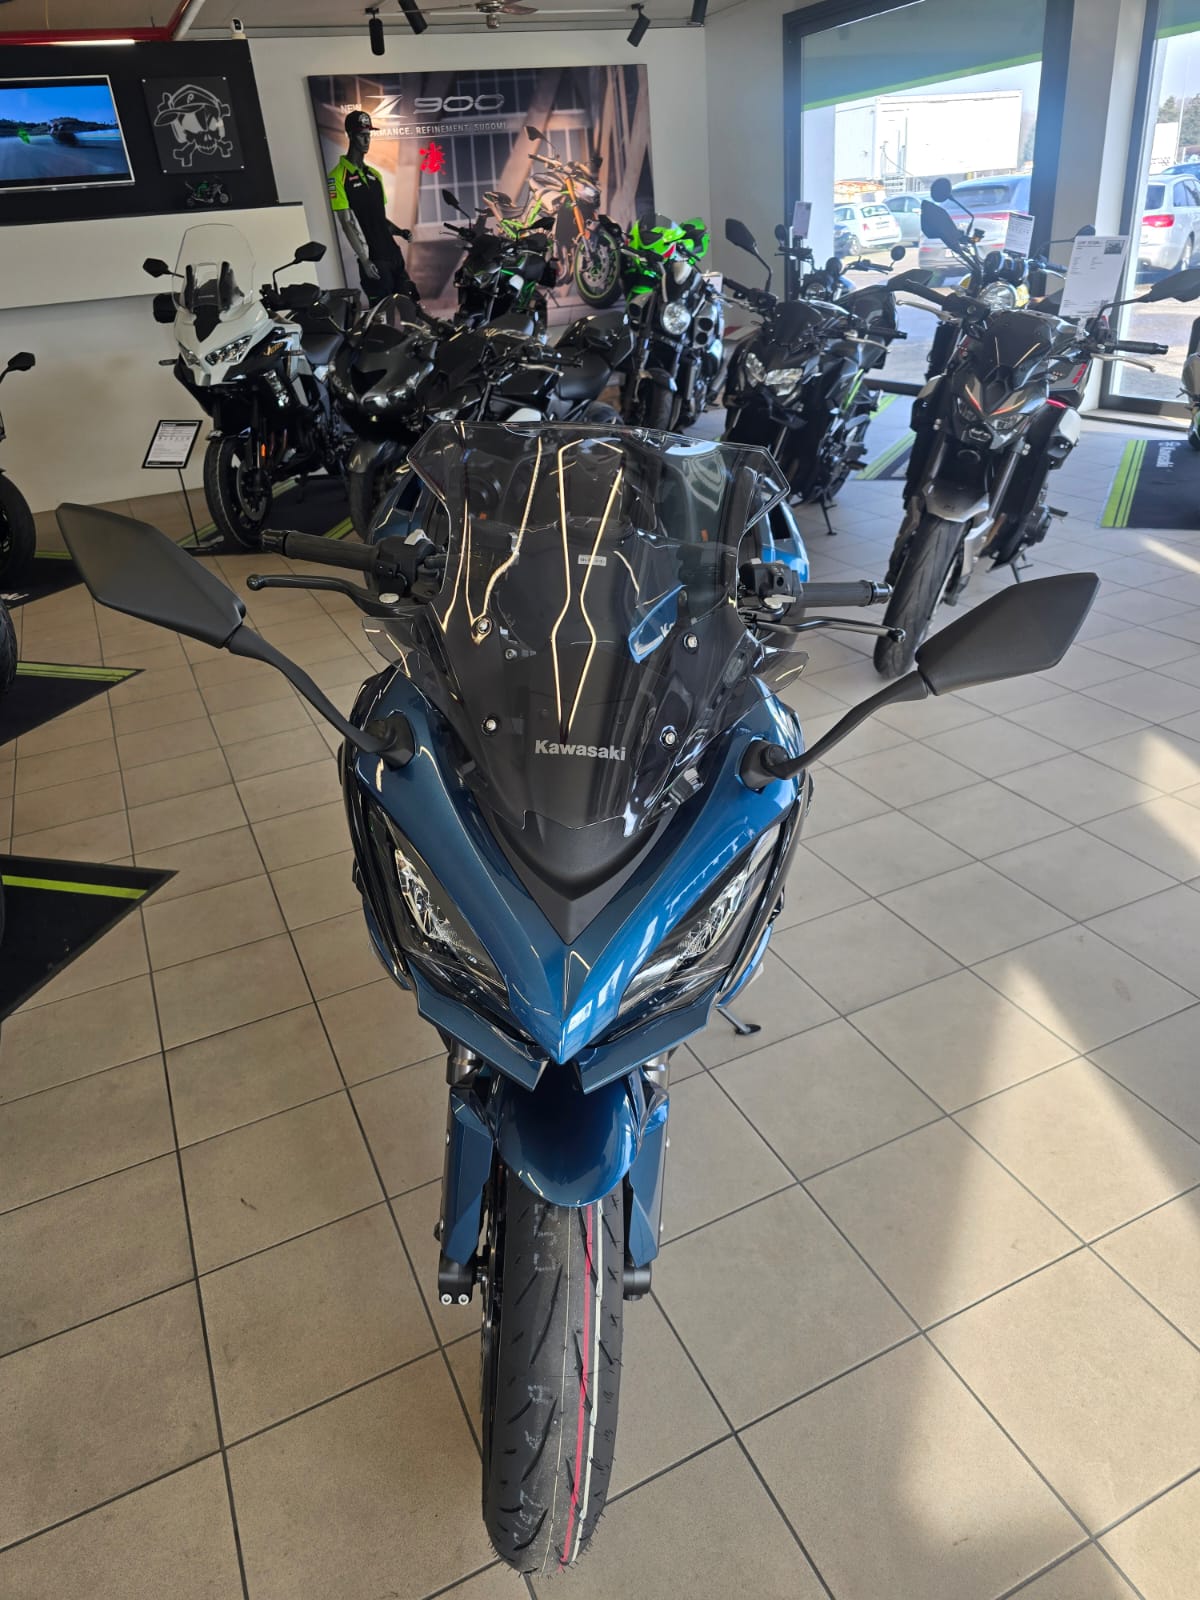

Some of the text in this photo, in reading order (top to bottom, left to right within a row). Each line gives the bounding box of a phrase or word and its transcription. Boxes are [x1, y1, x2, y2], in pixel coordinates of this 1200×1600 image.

[340, 103, 362, 114] NEW
[413, 94, 505, 115] 900
[534, 739, 627, 761] Kawasaki
